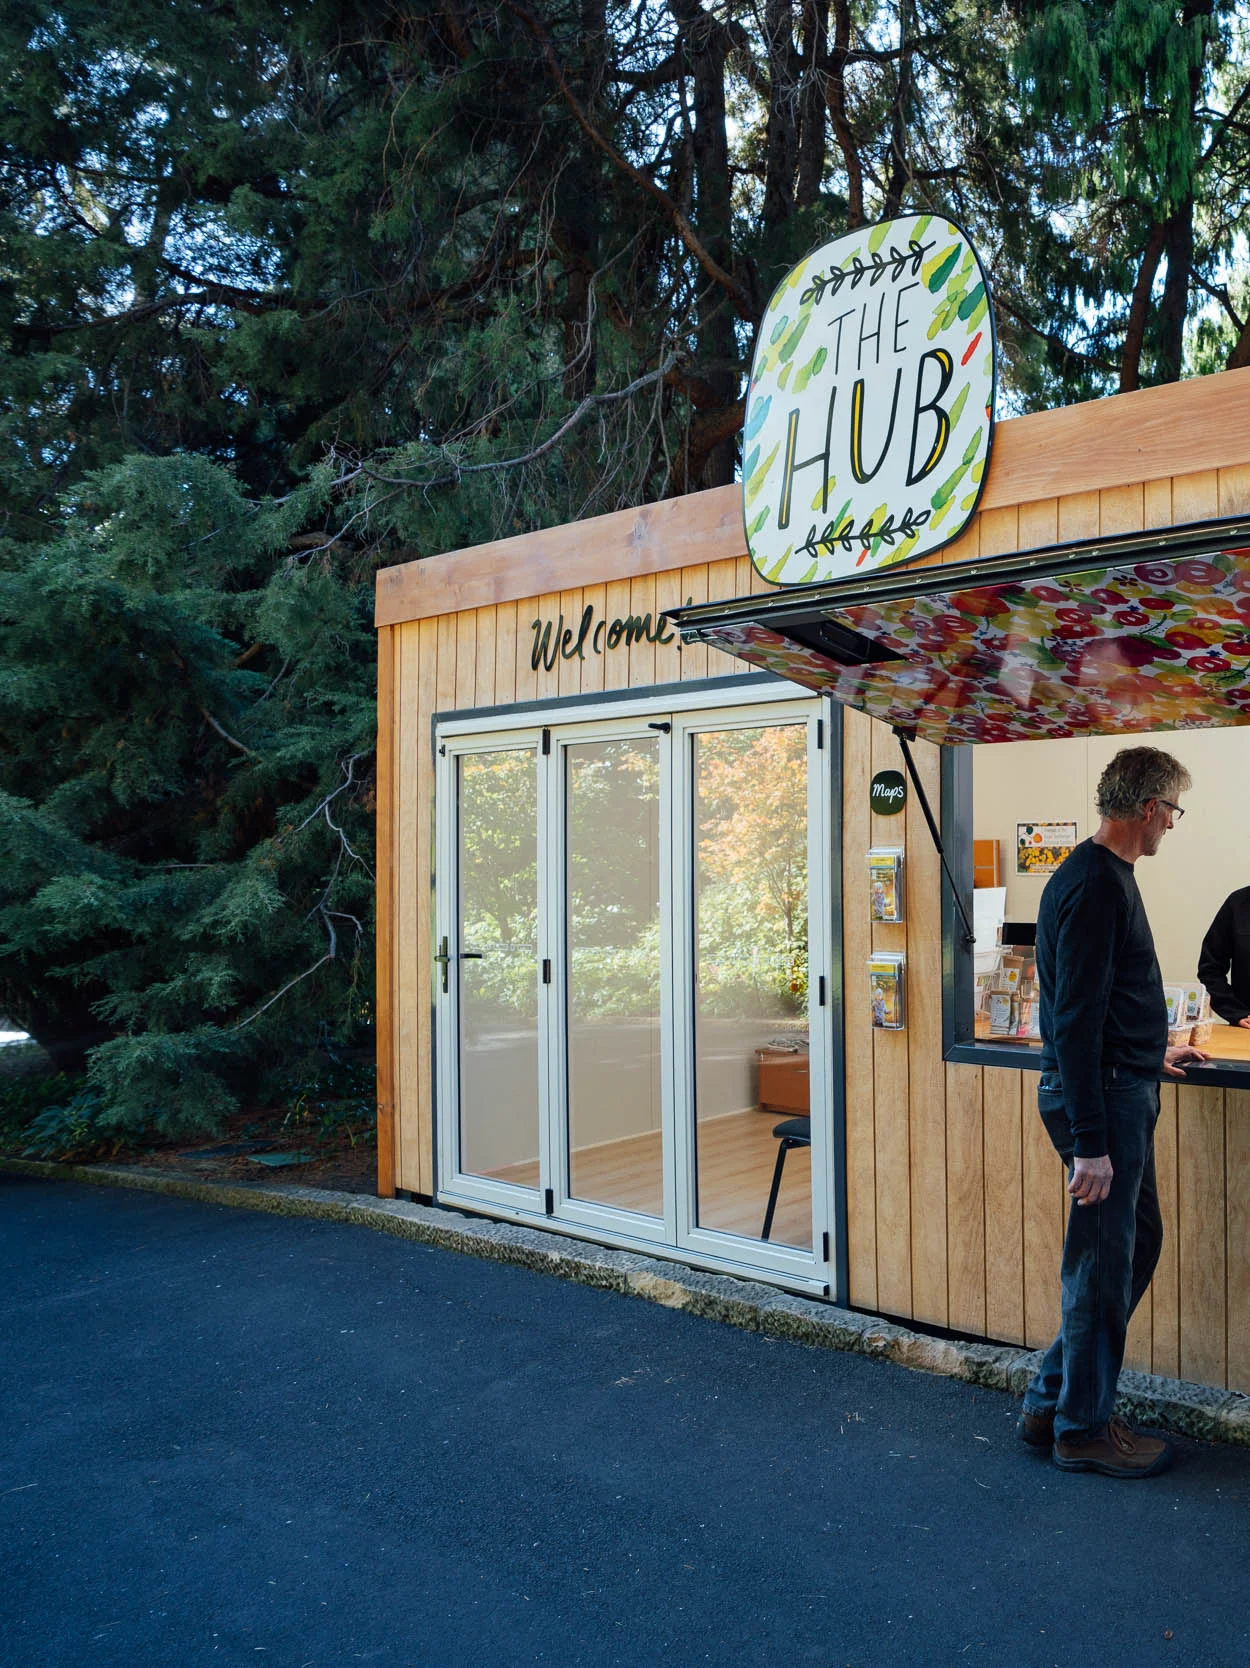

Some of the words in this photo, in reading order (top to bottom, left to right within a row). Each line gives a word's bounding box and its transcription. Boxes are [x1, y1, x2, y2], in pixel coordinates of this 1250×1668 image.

[827, 282, 920, 375] THE
[778, 348, 954, 530] HUB
[531, 597, 692, 672] Welcome
[872, 783, 904, 804] Maps
